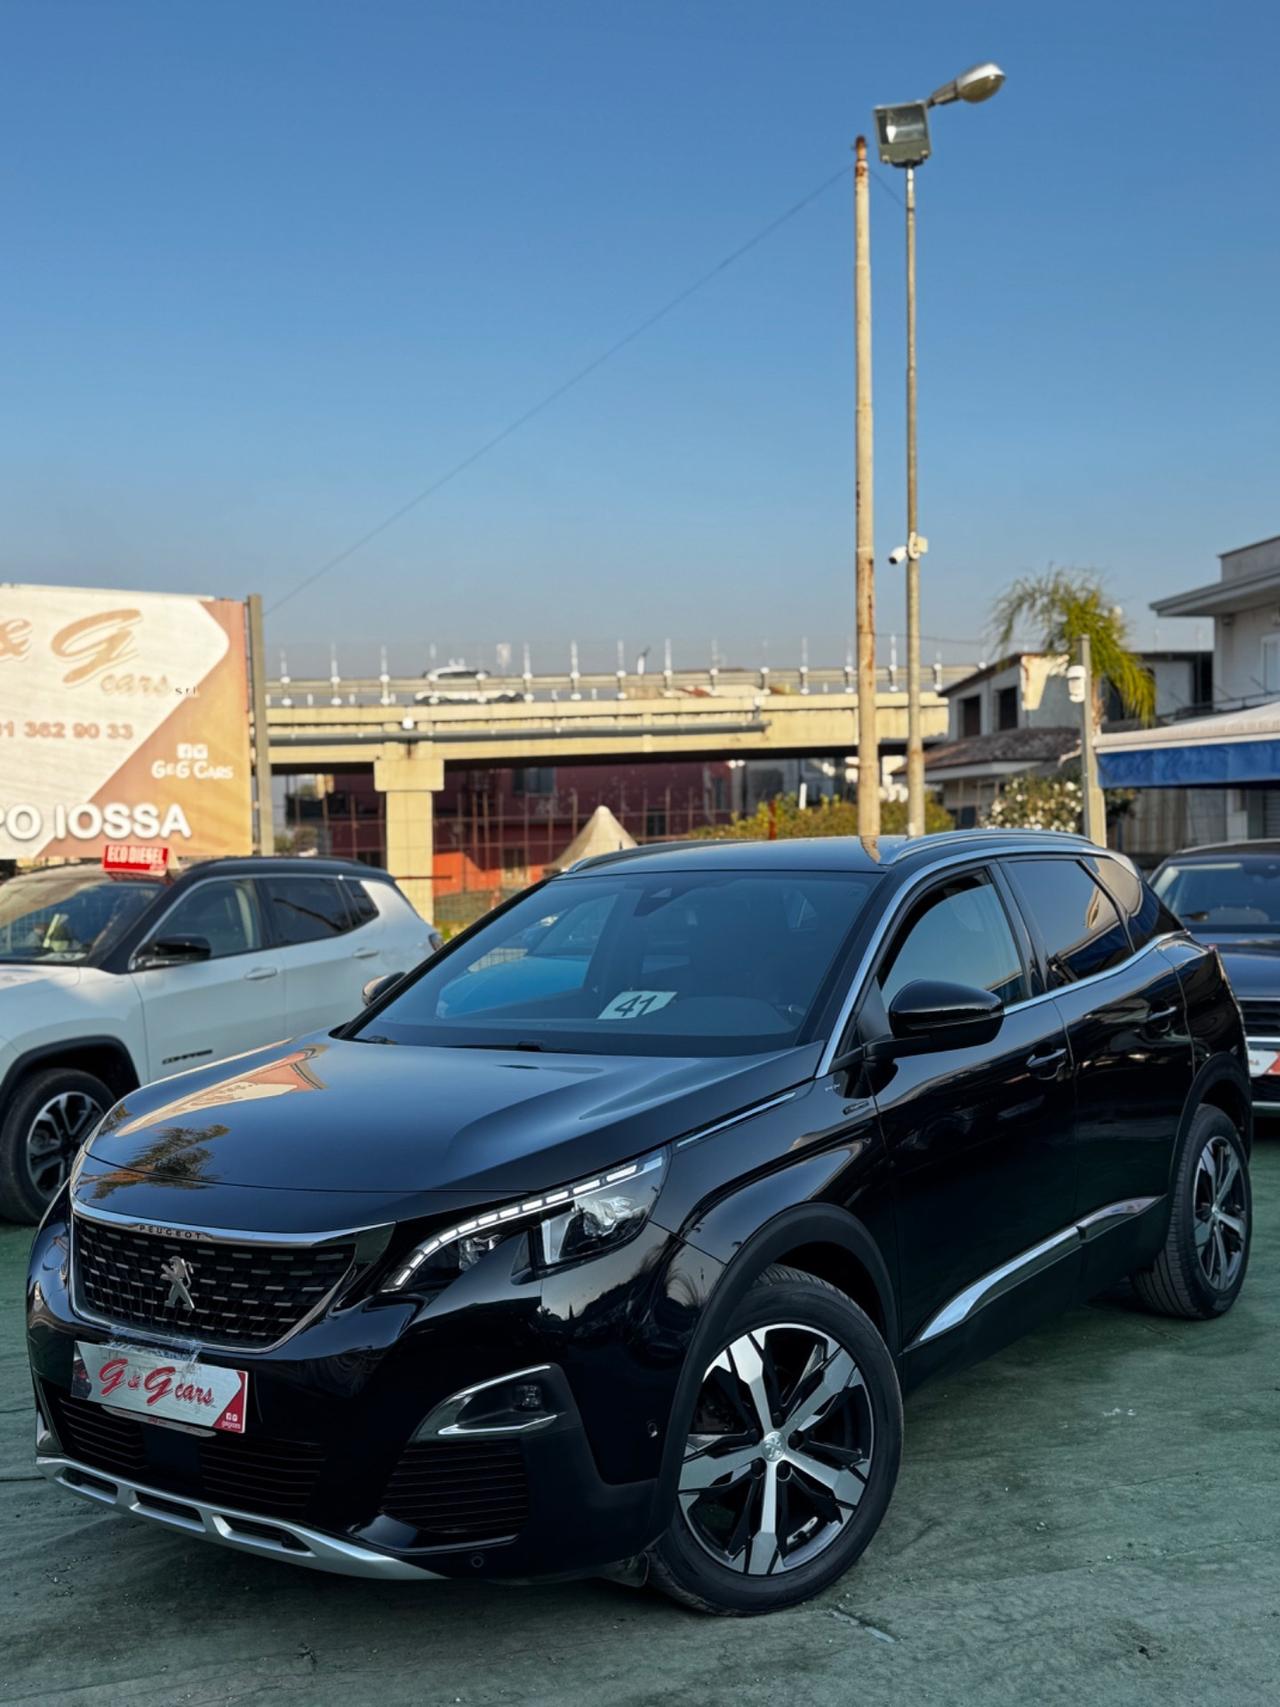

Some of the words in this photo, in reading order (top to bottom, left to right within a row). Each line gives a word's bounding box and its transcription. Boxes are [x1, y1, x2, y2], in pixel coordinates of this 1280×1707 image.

[0, 721, 14, 738] 1
[106, 723, 134, 740] 33
[0, 803, 42, 841] O
[55, 803, 192, 840] IOSSA
[614, 994, 657, 1018] 41
[140, 1224, 201, 1239] PEUGEOT
[174, 1382, 214, 1406] cars
